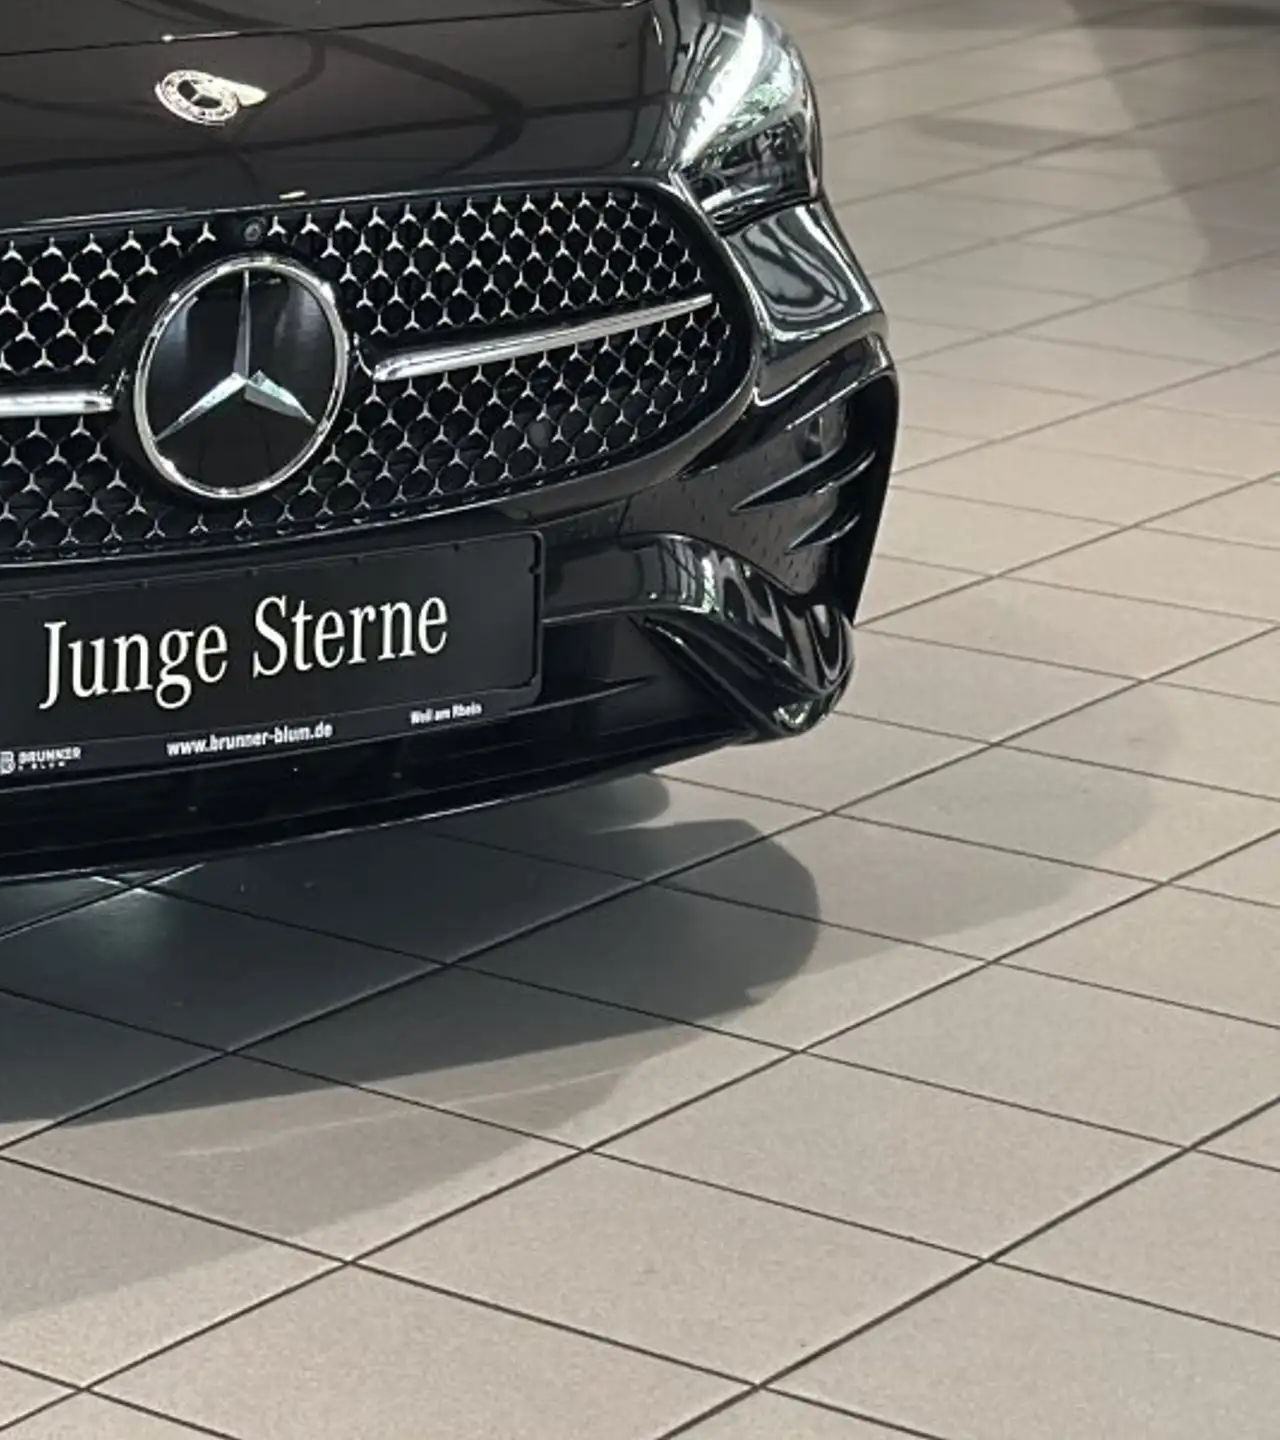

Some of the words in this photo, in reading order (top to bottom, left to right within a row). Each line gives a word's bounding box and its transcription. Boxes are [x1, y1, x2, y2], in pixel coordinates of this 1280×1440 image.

[38, 620, 228, 710] Junge
[252, 594, 449, 678] Sterne
[166, 720, 334, 757] www.brunner-blum.de
